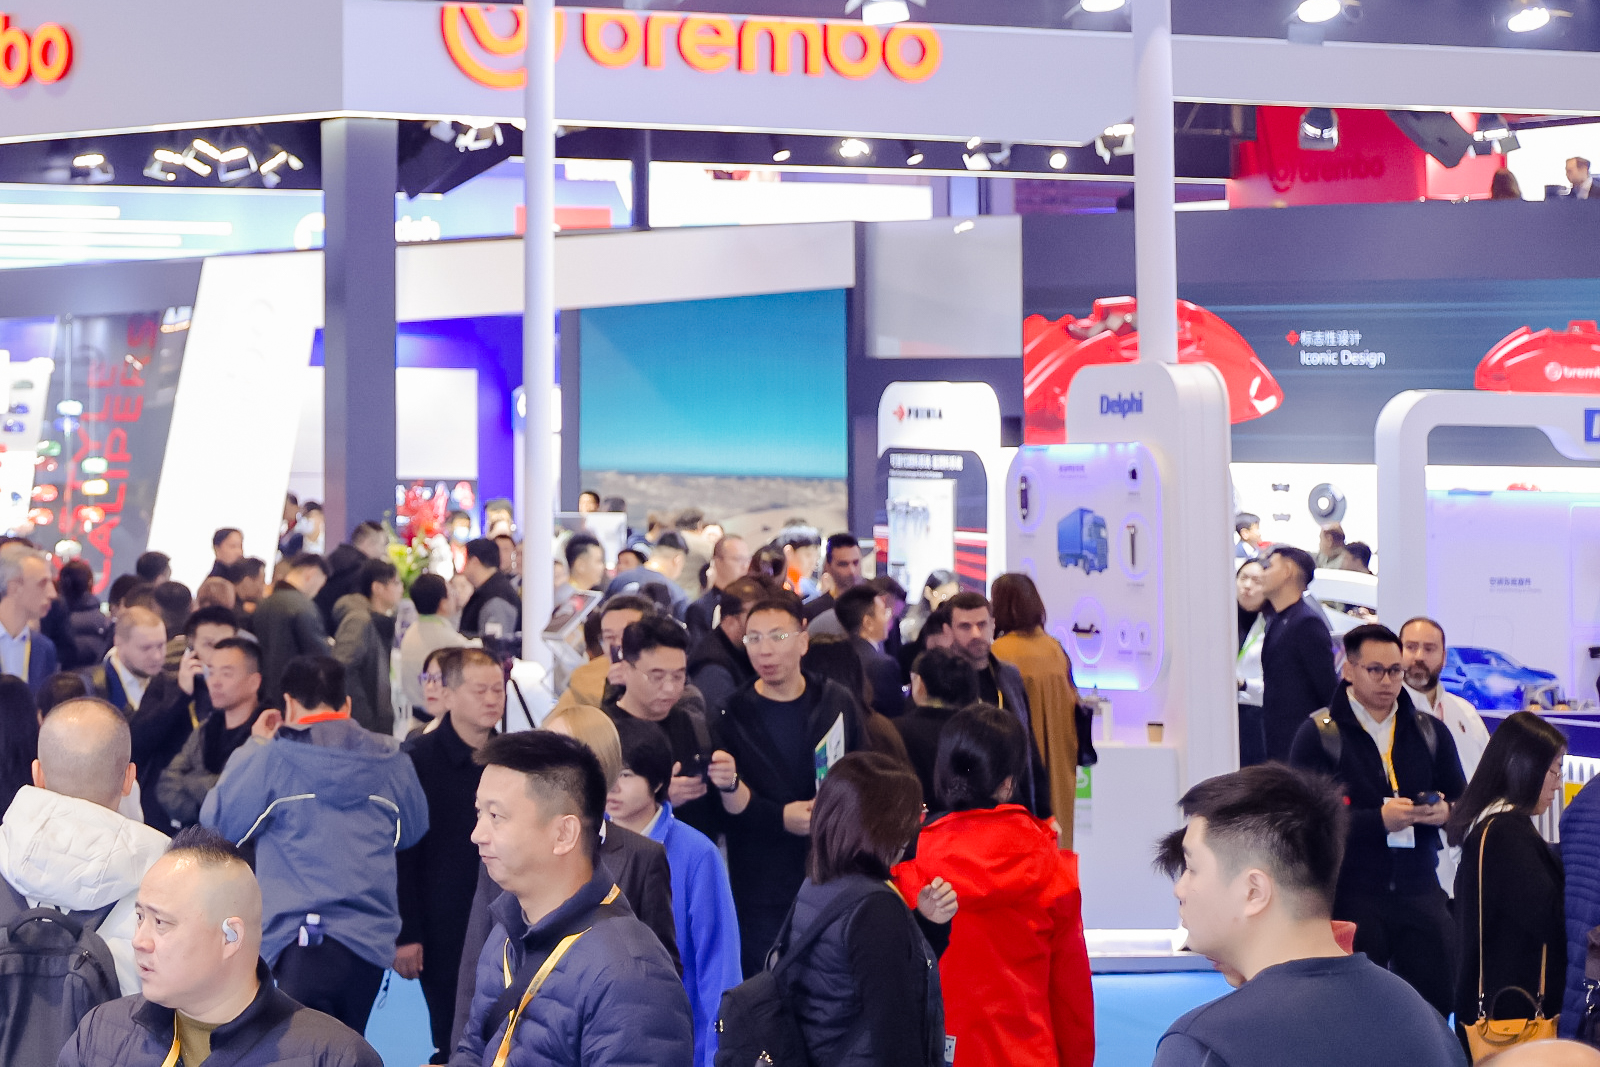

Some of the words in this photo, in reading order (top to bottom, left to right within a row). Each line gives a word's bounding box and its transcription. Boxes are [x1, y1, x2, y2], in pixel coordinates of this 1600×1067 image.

[582, 7, 944, 83] brembo
[1300, 349, 1338, 365] Iconic
[1340, 348, 1386, 368] Design
[1100, 392, 1143, 419] Delphi
